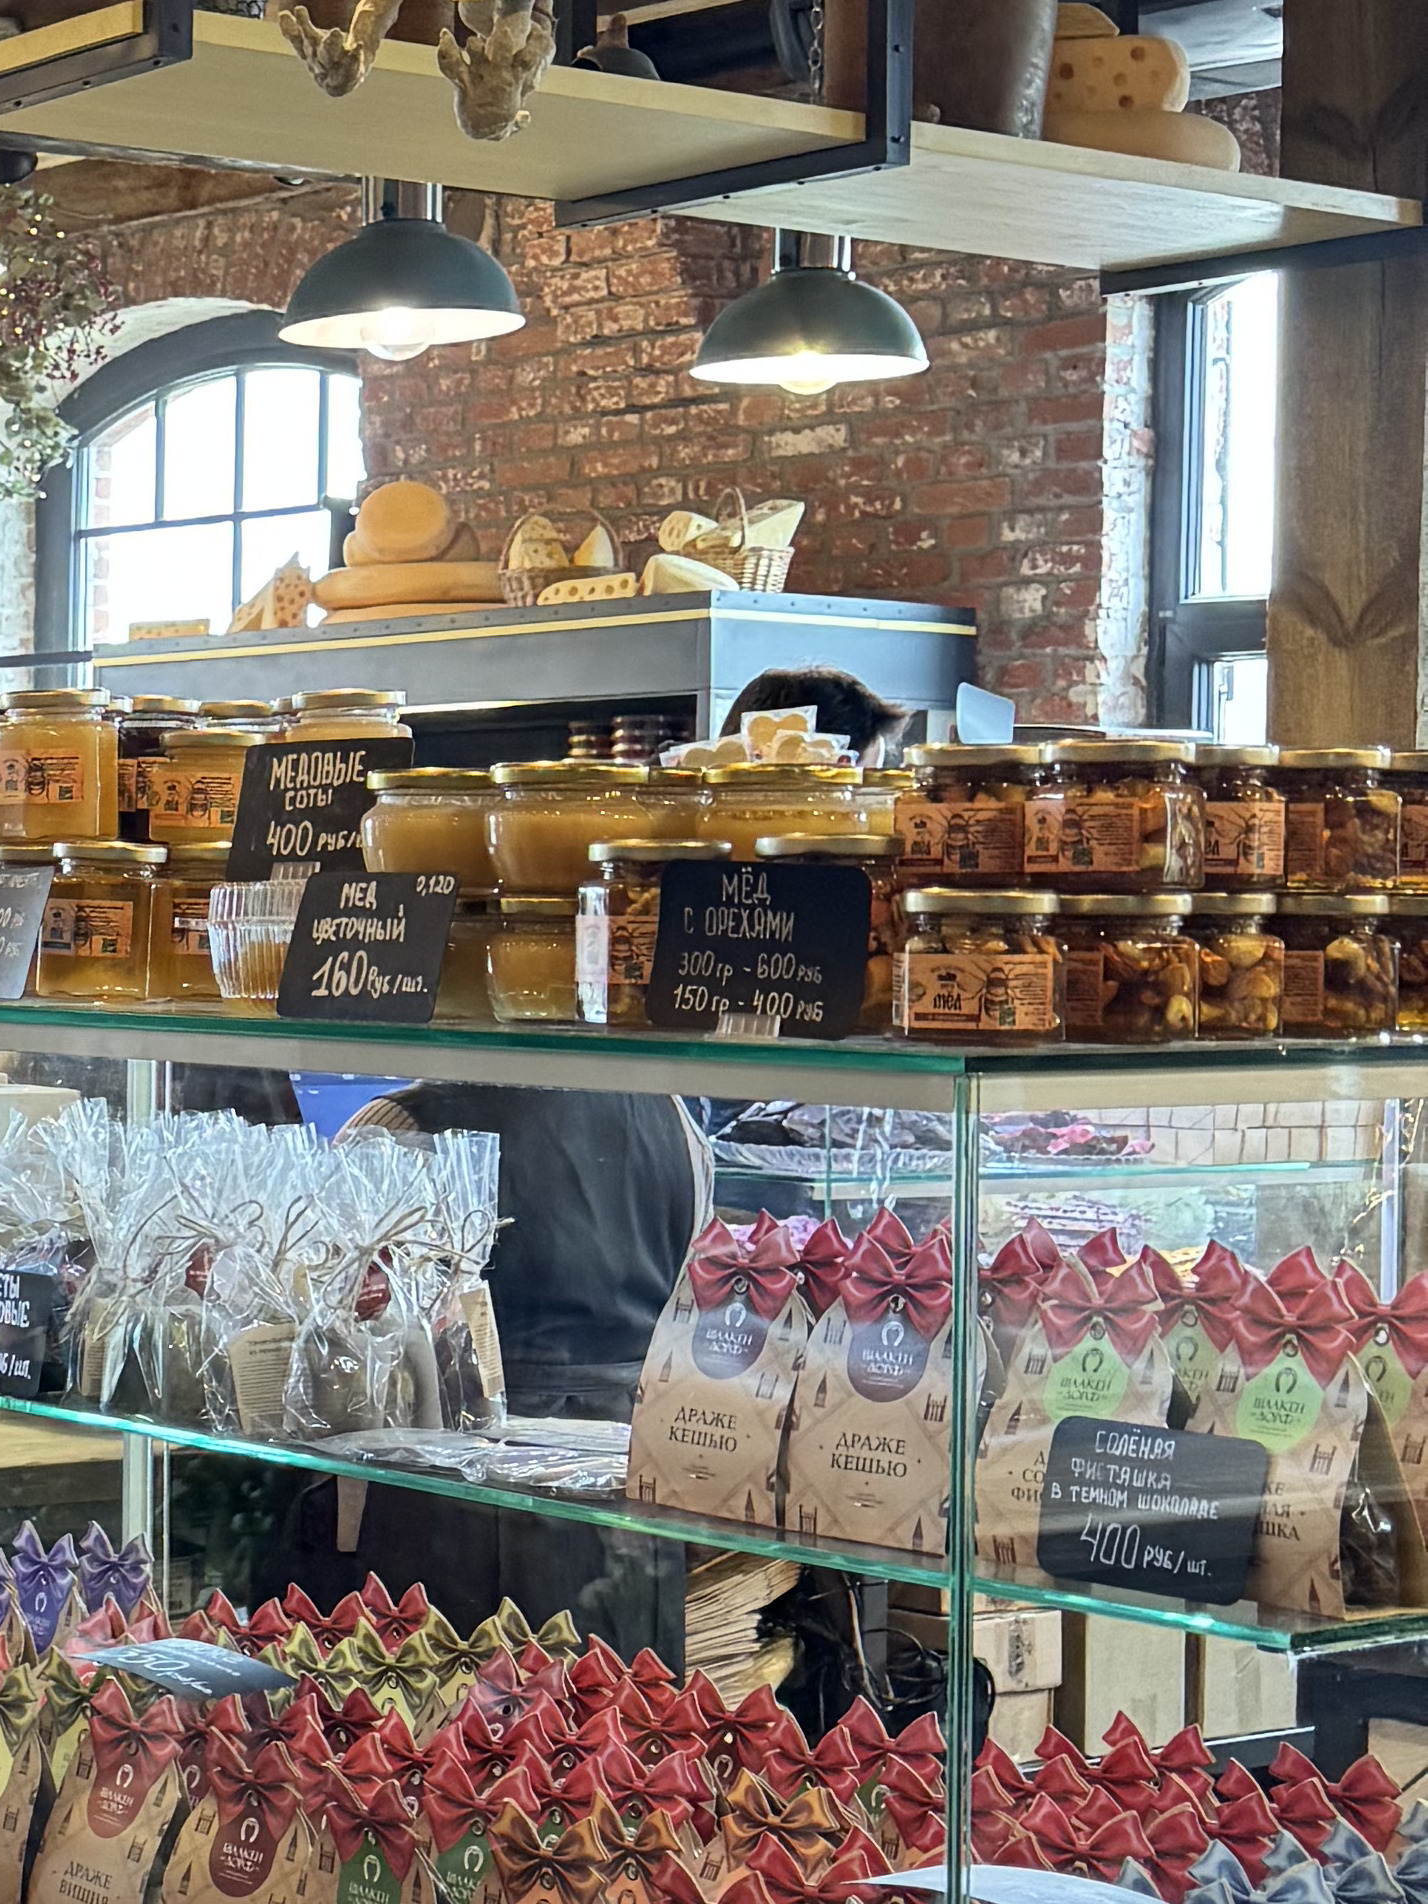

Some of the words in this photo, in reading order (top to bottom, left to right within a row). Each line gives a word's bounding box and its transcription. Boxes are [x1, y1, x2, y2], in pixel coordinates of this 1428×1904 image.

[270, 751, 366, 790] МЕДОВЫЕ
[285, 789, 332, 810] СОТЫ
[267, 820, 313, 856] 400
[340, 880, 377, 910] МЕД
[722, 867, 771, 905] МЁД
[312, 904, 406, 946] ЦВЕТОЧНЫЙ
[684, 907, 694, 934] С
[704, 906, 795, 943] ОРЕХАМИ
[311, 950, 368, 997] 160
[757, 953, 796, 980] 600
[753, 989, 794, 1018] 400
[674, 1406, 738, 1430] ДРАЖЕ
[668, 1426, 738, 1452] КЕШЬЮ
[835, 1432, 906, 1455] ДРАЖЕ
[1095, 1428, 1176, 1461] СОЛЁНАЯ
[830, 1453, 908, 1478] КЕШЬЮ
[1071, 1457, 1172, 1490] ФИСТАШКА
[1051, 1482, 1061, 1499] В
[1070, 1485, 1128, 1509] ТЕМНОМ
[1137, 1492, 1220, 1520] ШОКОЛАДЕ
[1080, 1512, 1140, 1570] 400
[63, 1861, 113, 1890] ДРАЖЕ
